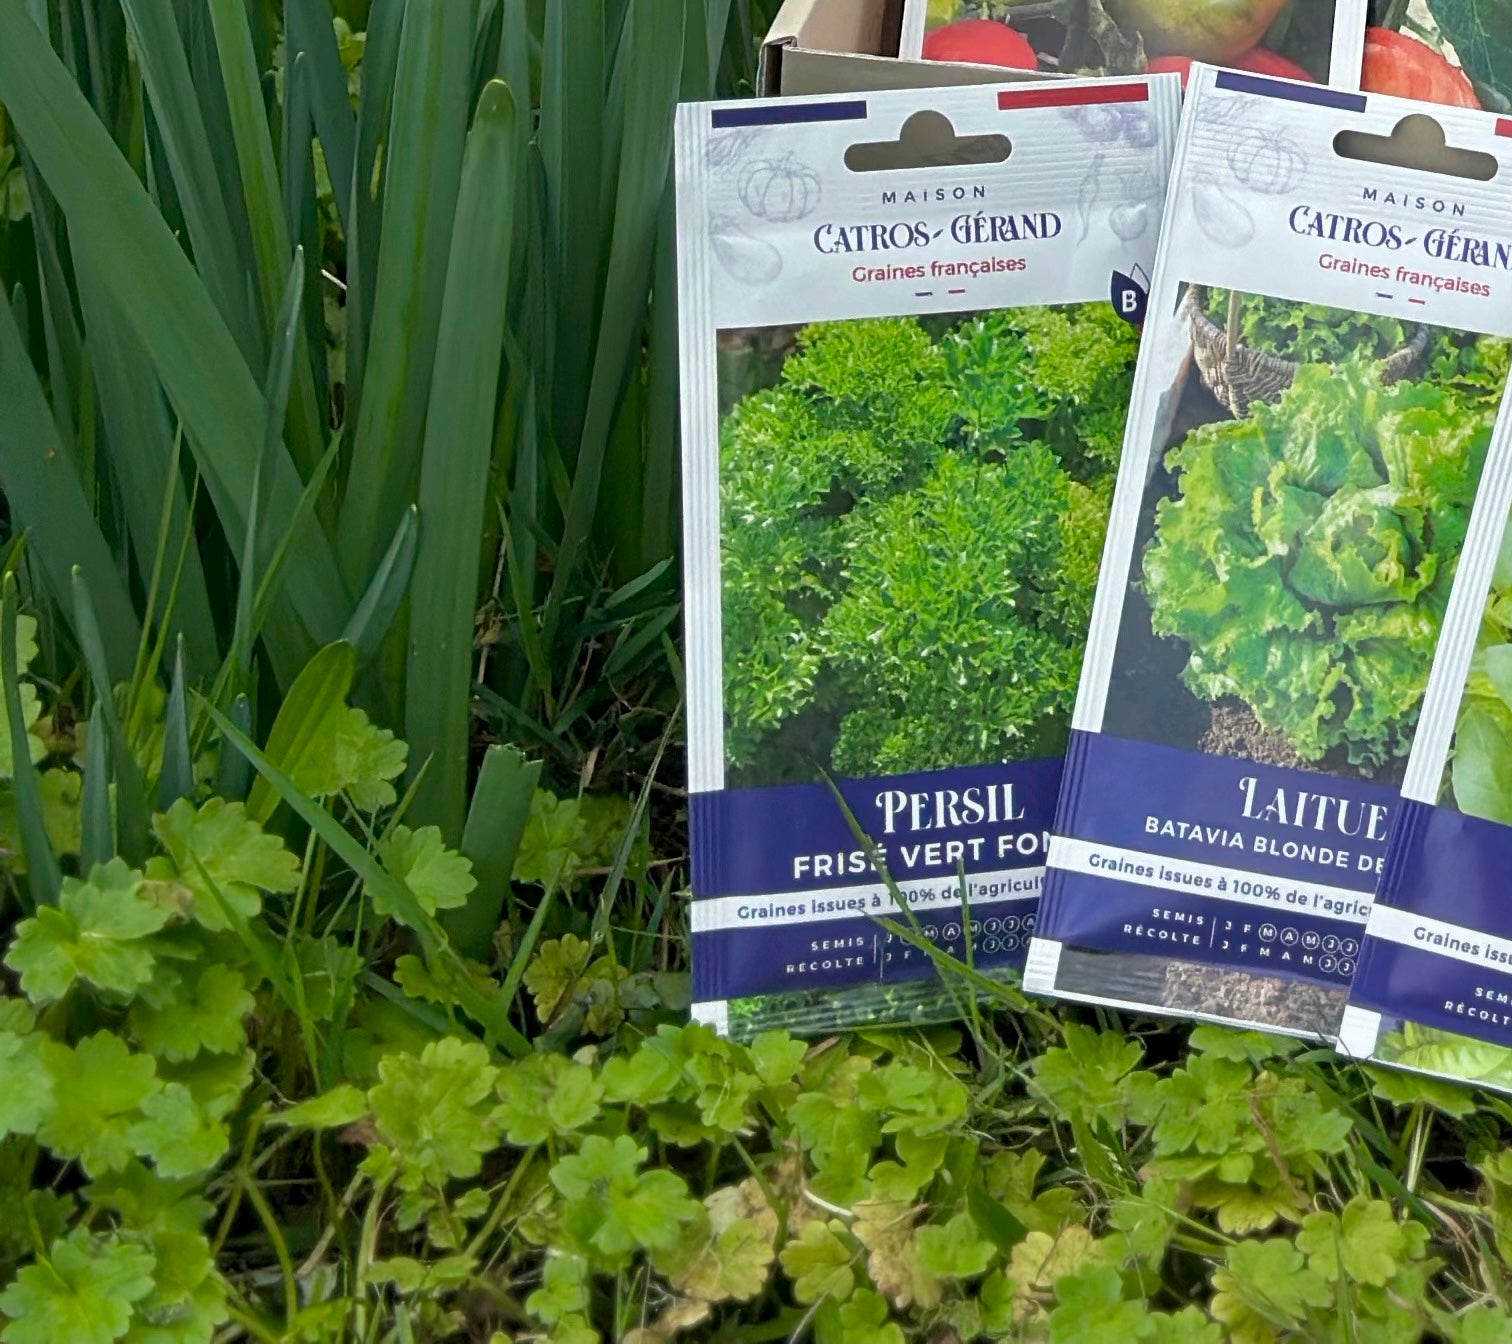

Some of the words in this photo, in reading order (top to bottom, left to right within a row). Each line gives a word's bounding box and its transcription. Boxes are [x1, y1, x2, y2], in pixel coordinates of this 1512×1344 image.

[882, 185, 985, 204] MAISON
[1363, 187, 1465, 216] MAISON
[852, 264, 925, 282] Graines
[930, 257, 1026, 278] françaises
[1319, 254, 1390, 279] Graines
[1396, 266, 1490, 297] françaises
[1122, 289, 1138, 312] B
[875, 783, 1024, 833] PERSIL
[1239, 777, 1387, 841] LAITUE
[901, 837, 986, 869] VERT
[1145, 816, 1244, 849] BATAVIA
[1253, 836, 1350, 868] BLONDE
[1358, 854, 1385, 874] DE
[1089, 853, 1154, 878] Graines
[1159, 865, 1213, 888] issues
[1217, 876, 1227, 891] à
[1233, 880, 1280, 901] 100%
[1286, 890, 1308, 905] de
[737, 904, 806, 920] Graines
[811, 898, 866, 915] issues
[871, 893, 881, 908] à
[1152, 908, 1203, 925] SEMIS
[811, 937, 864, 951] SEMIS
[1124, 924, 1200, 945] RÉCOLTE
[1414, 927, 1480, 955] Graines
